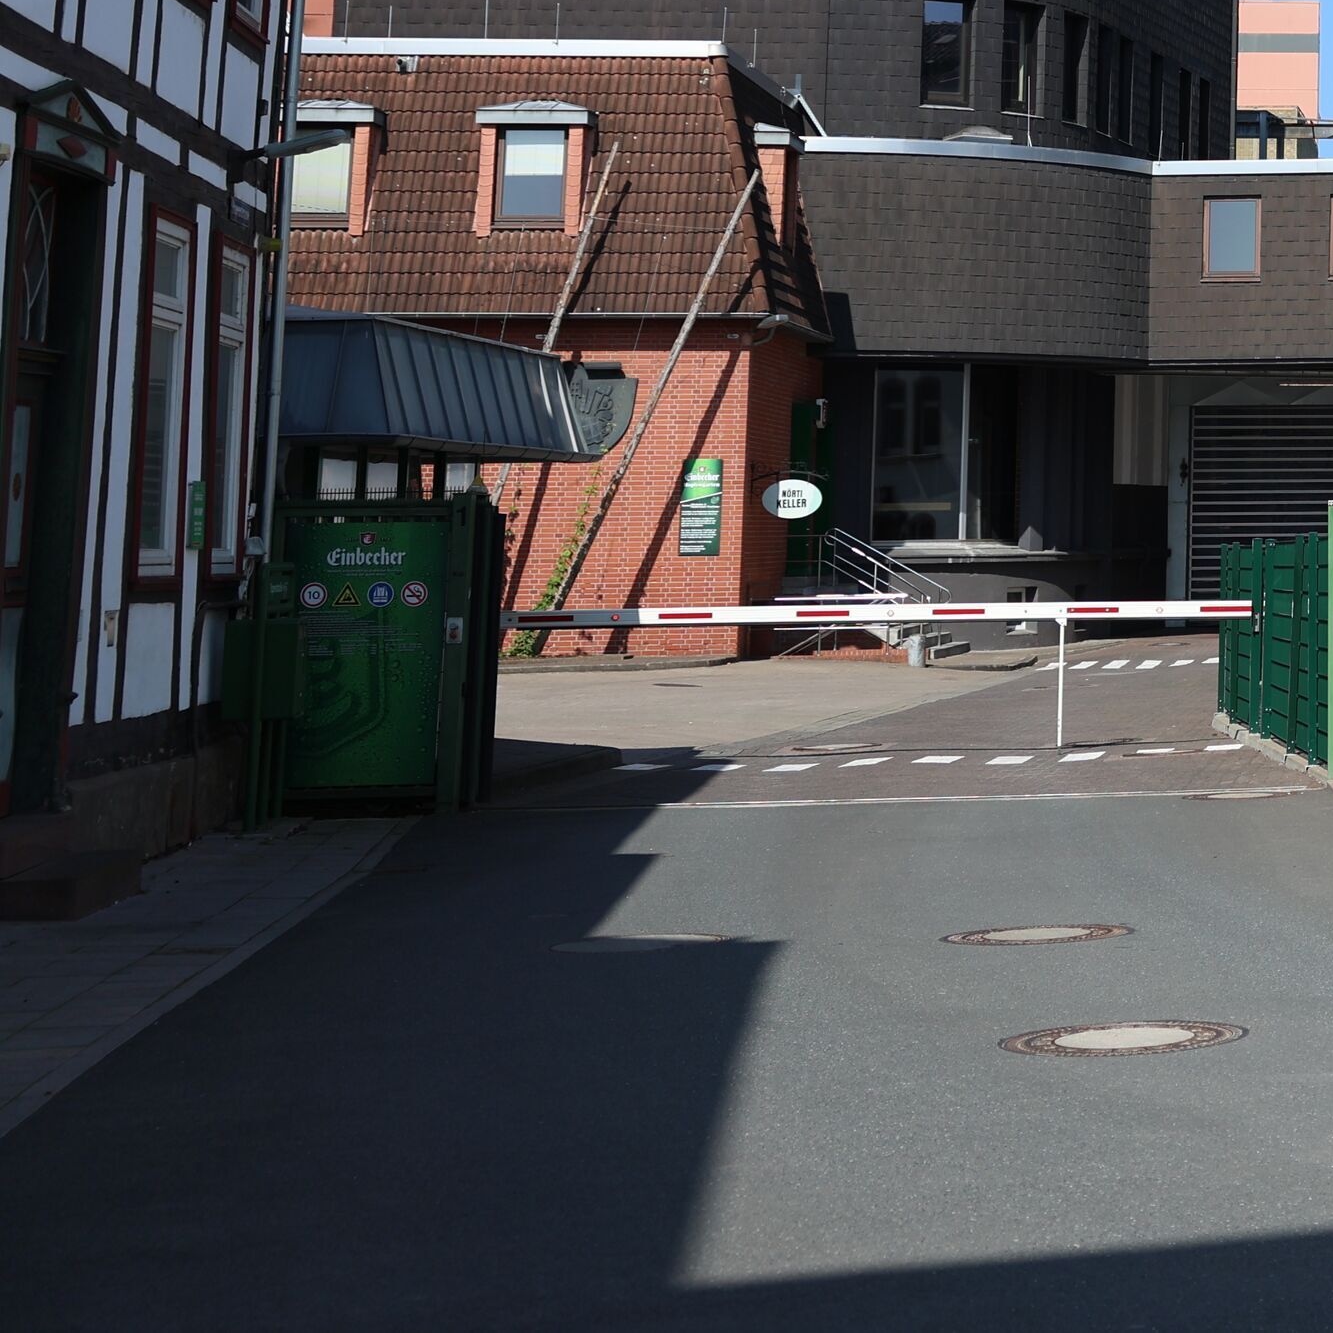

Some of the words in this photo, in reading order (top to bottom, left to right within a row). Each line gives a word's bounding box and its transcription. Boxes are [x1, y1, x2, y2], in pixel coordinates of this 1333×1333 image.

[776, 499, 807, 509] KELLER
[326, 546, 407, 566] Einbecker
[308, 590, 320, 600] 10
